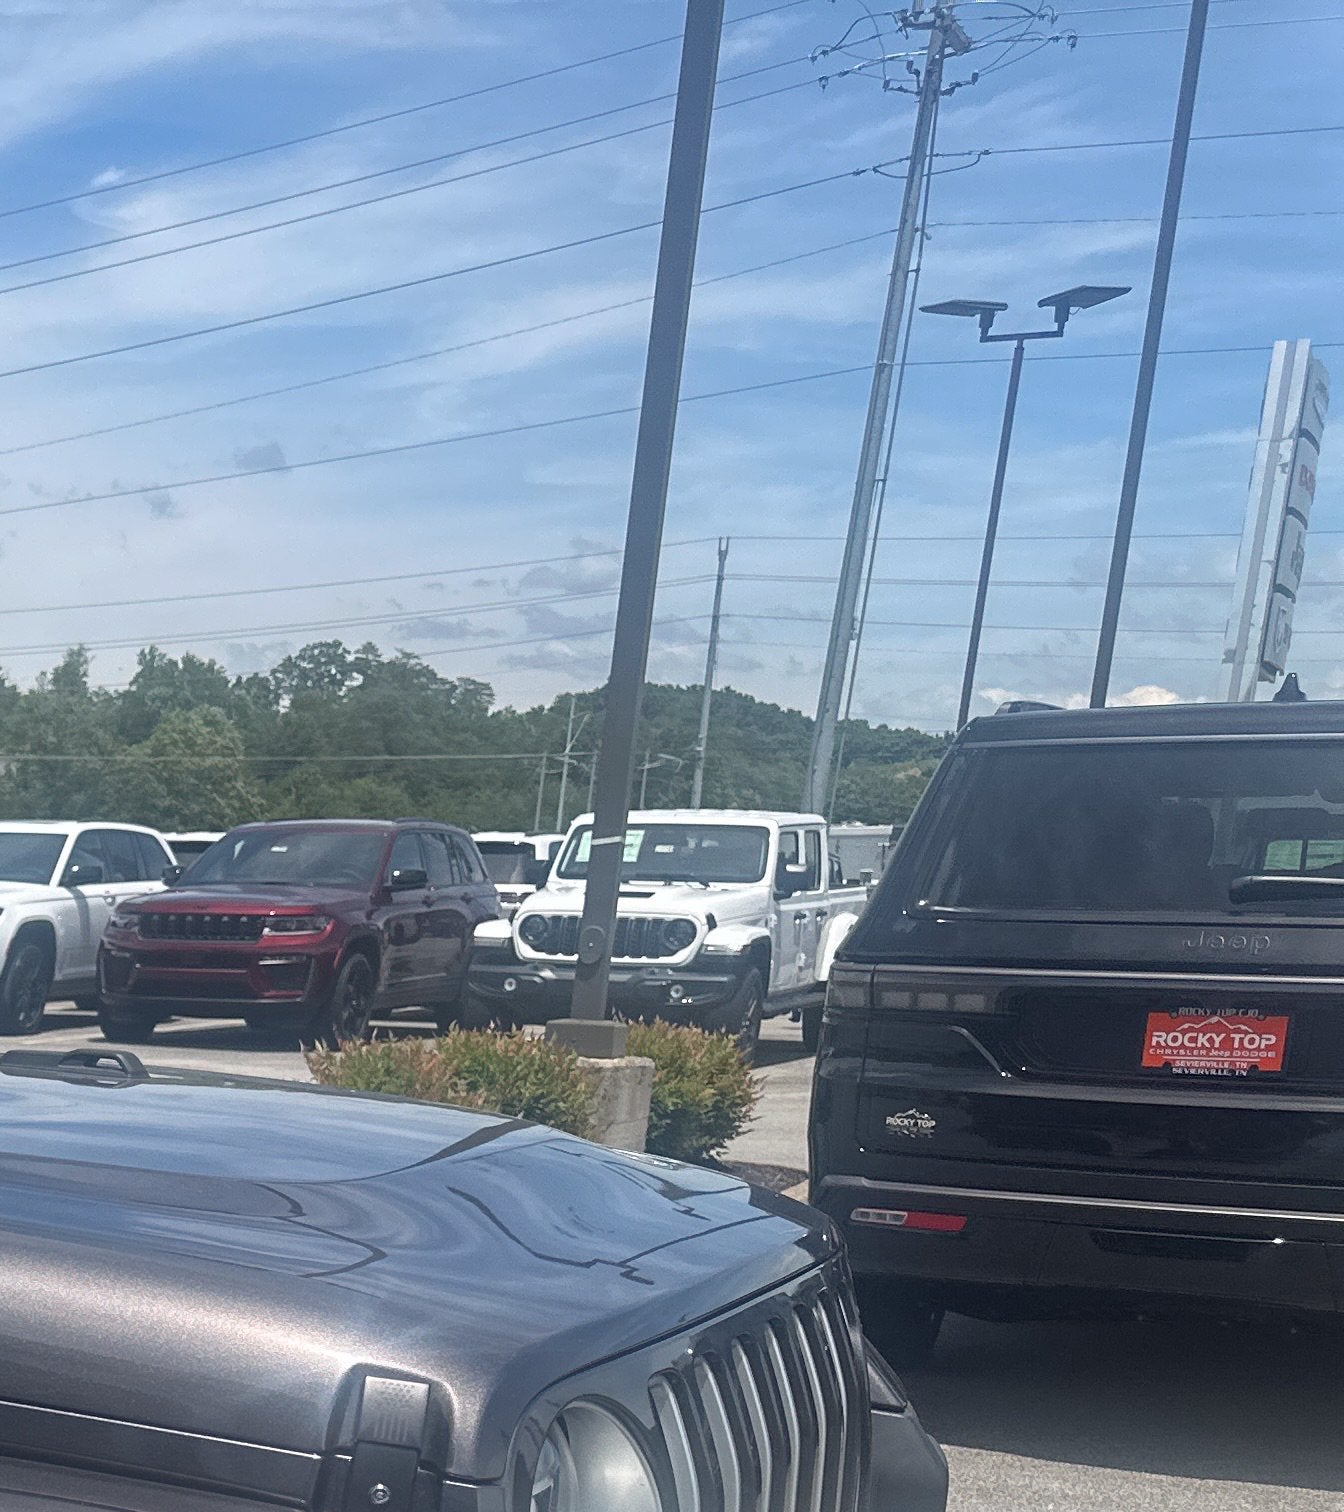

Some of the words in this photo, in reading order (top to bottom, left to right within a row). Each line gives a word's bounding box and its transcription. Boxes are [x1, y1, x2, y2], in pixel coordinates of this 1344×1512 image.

[1181, 930, 1272, 956] Jeep
[1150, 1031, 1227, 1048] ROCKY
[1230, 1033, 1278, 1050] TOP
[1148, 1048, 1207, 1057] CHRYSLER
[1208, 1048, 1231, 1058] Jeep
[1232, 1050, 1277, 1058] DODGE
[887, 1117, 915, 1126] ROCKY
[917, 1119, 936, 1127] TOP
